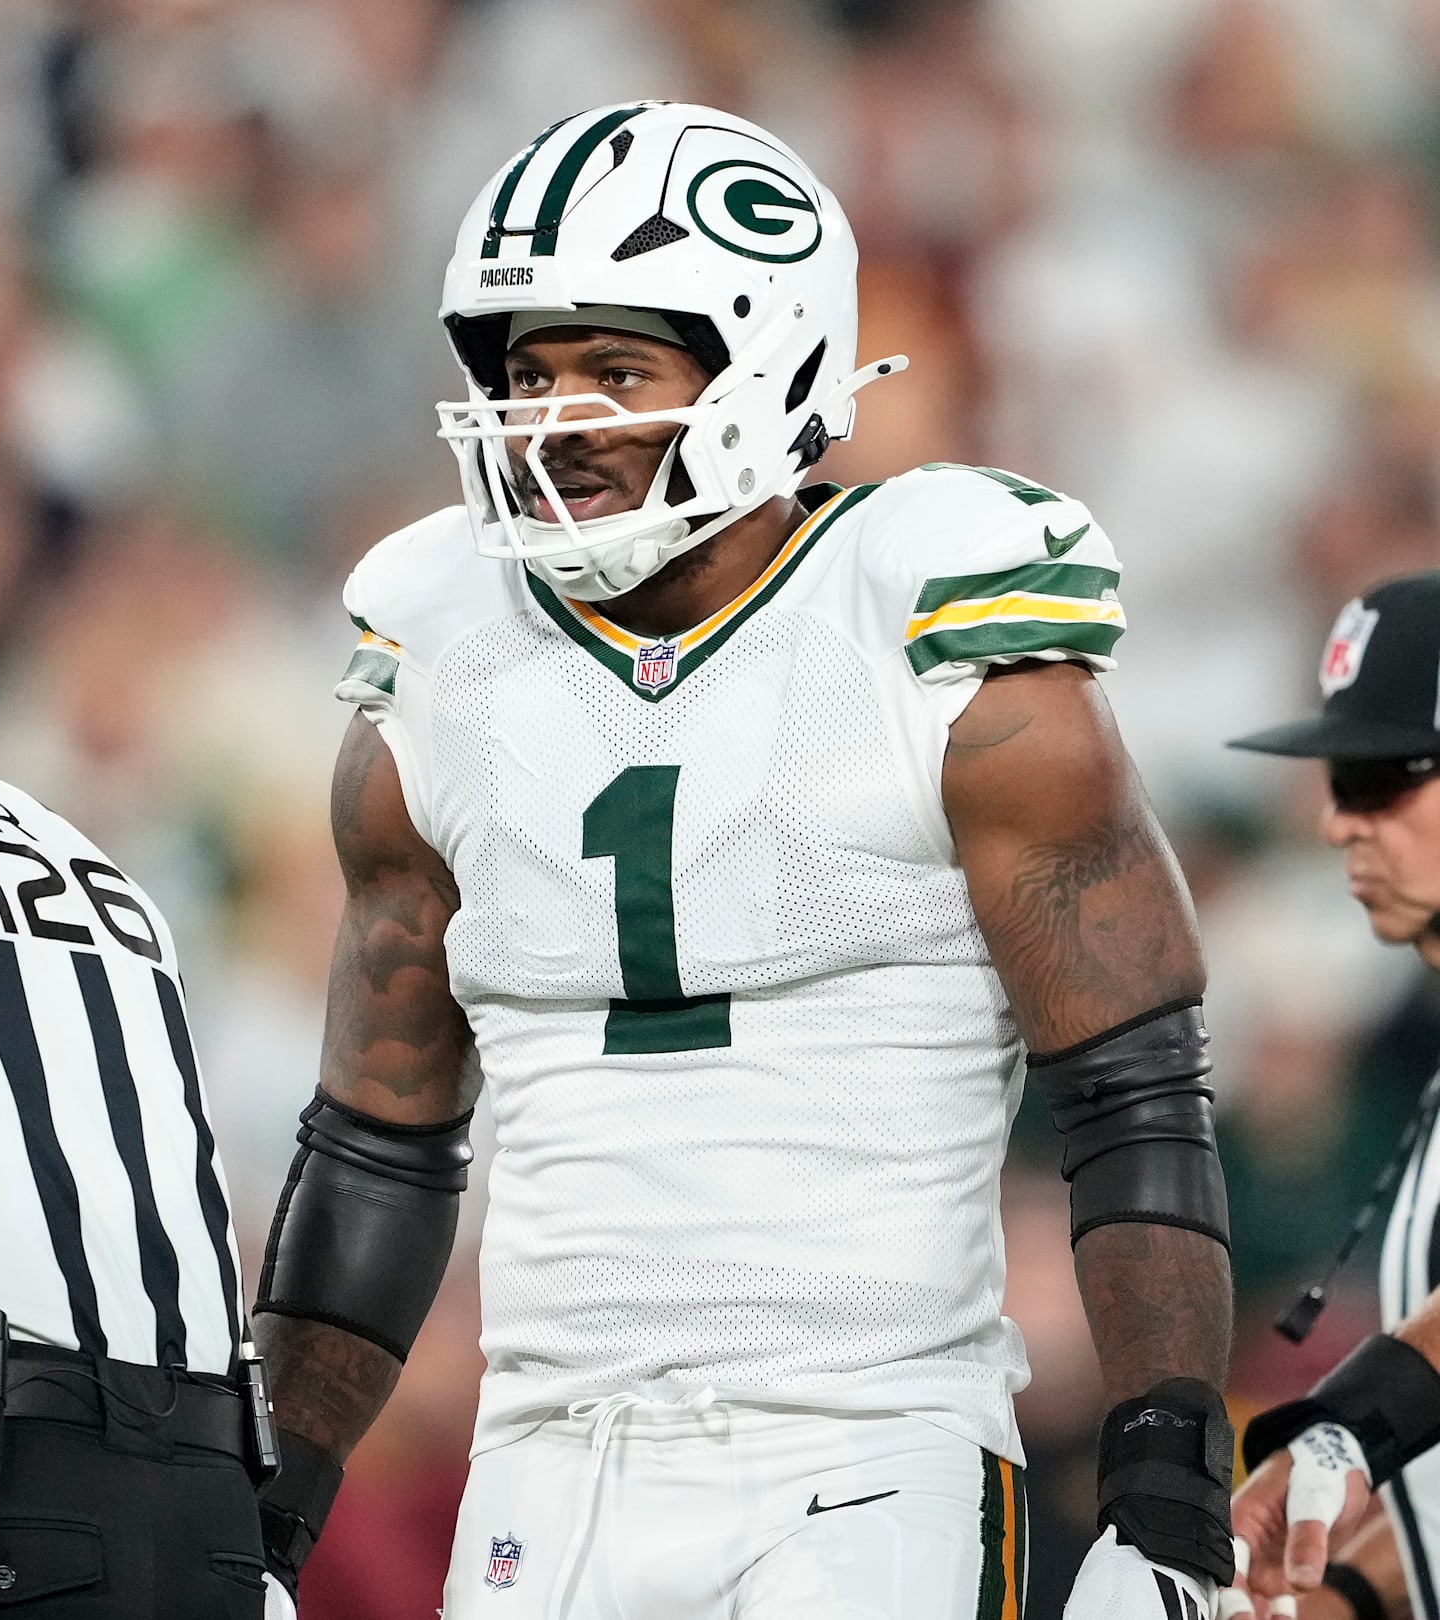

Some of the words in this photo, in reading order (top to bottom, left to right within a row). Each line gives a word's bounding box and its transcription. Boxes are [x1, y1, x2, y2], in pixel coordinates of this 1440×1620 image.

[686, 159, 823, 264] G
[480, 267, 534, 288] PACKERS
[640, 661, 669, 682] NFL
[582, 765, 731, 1055] 1
[489, 1559, 514, 1581] NFL
